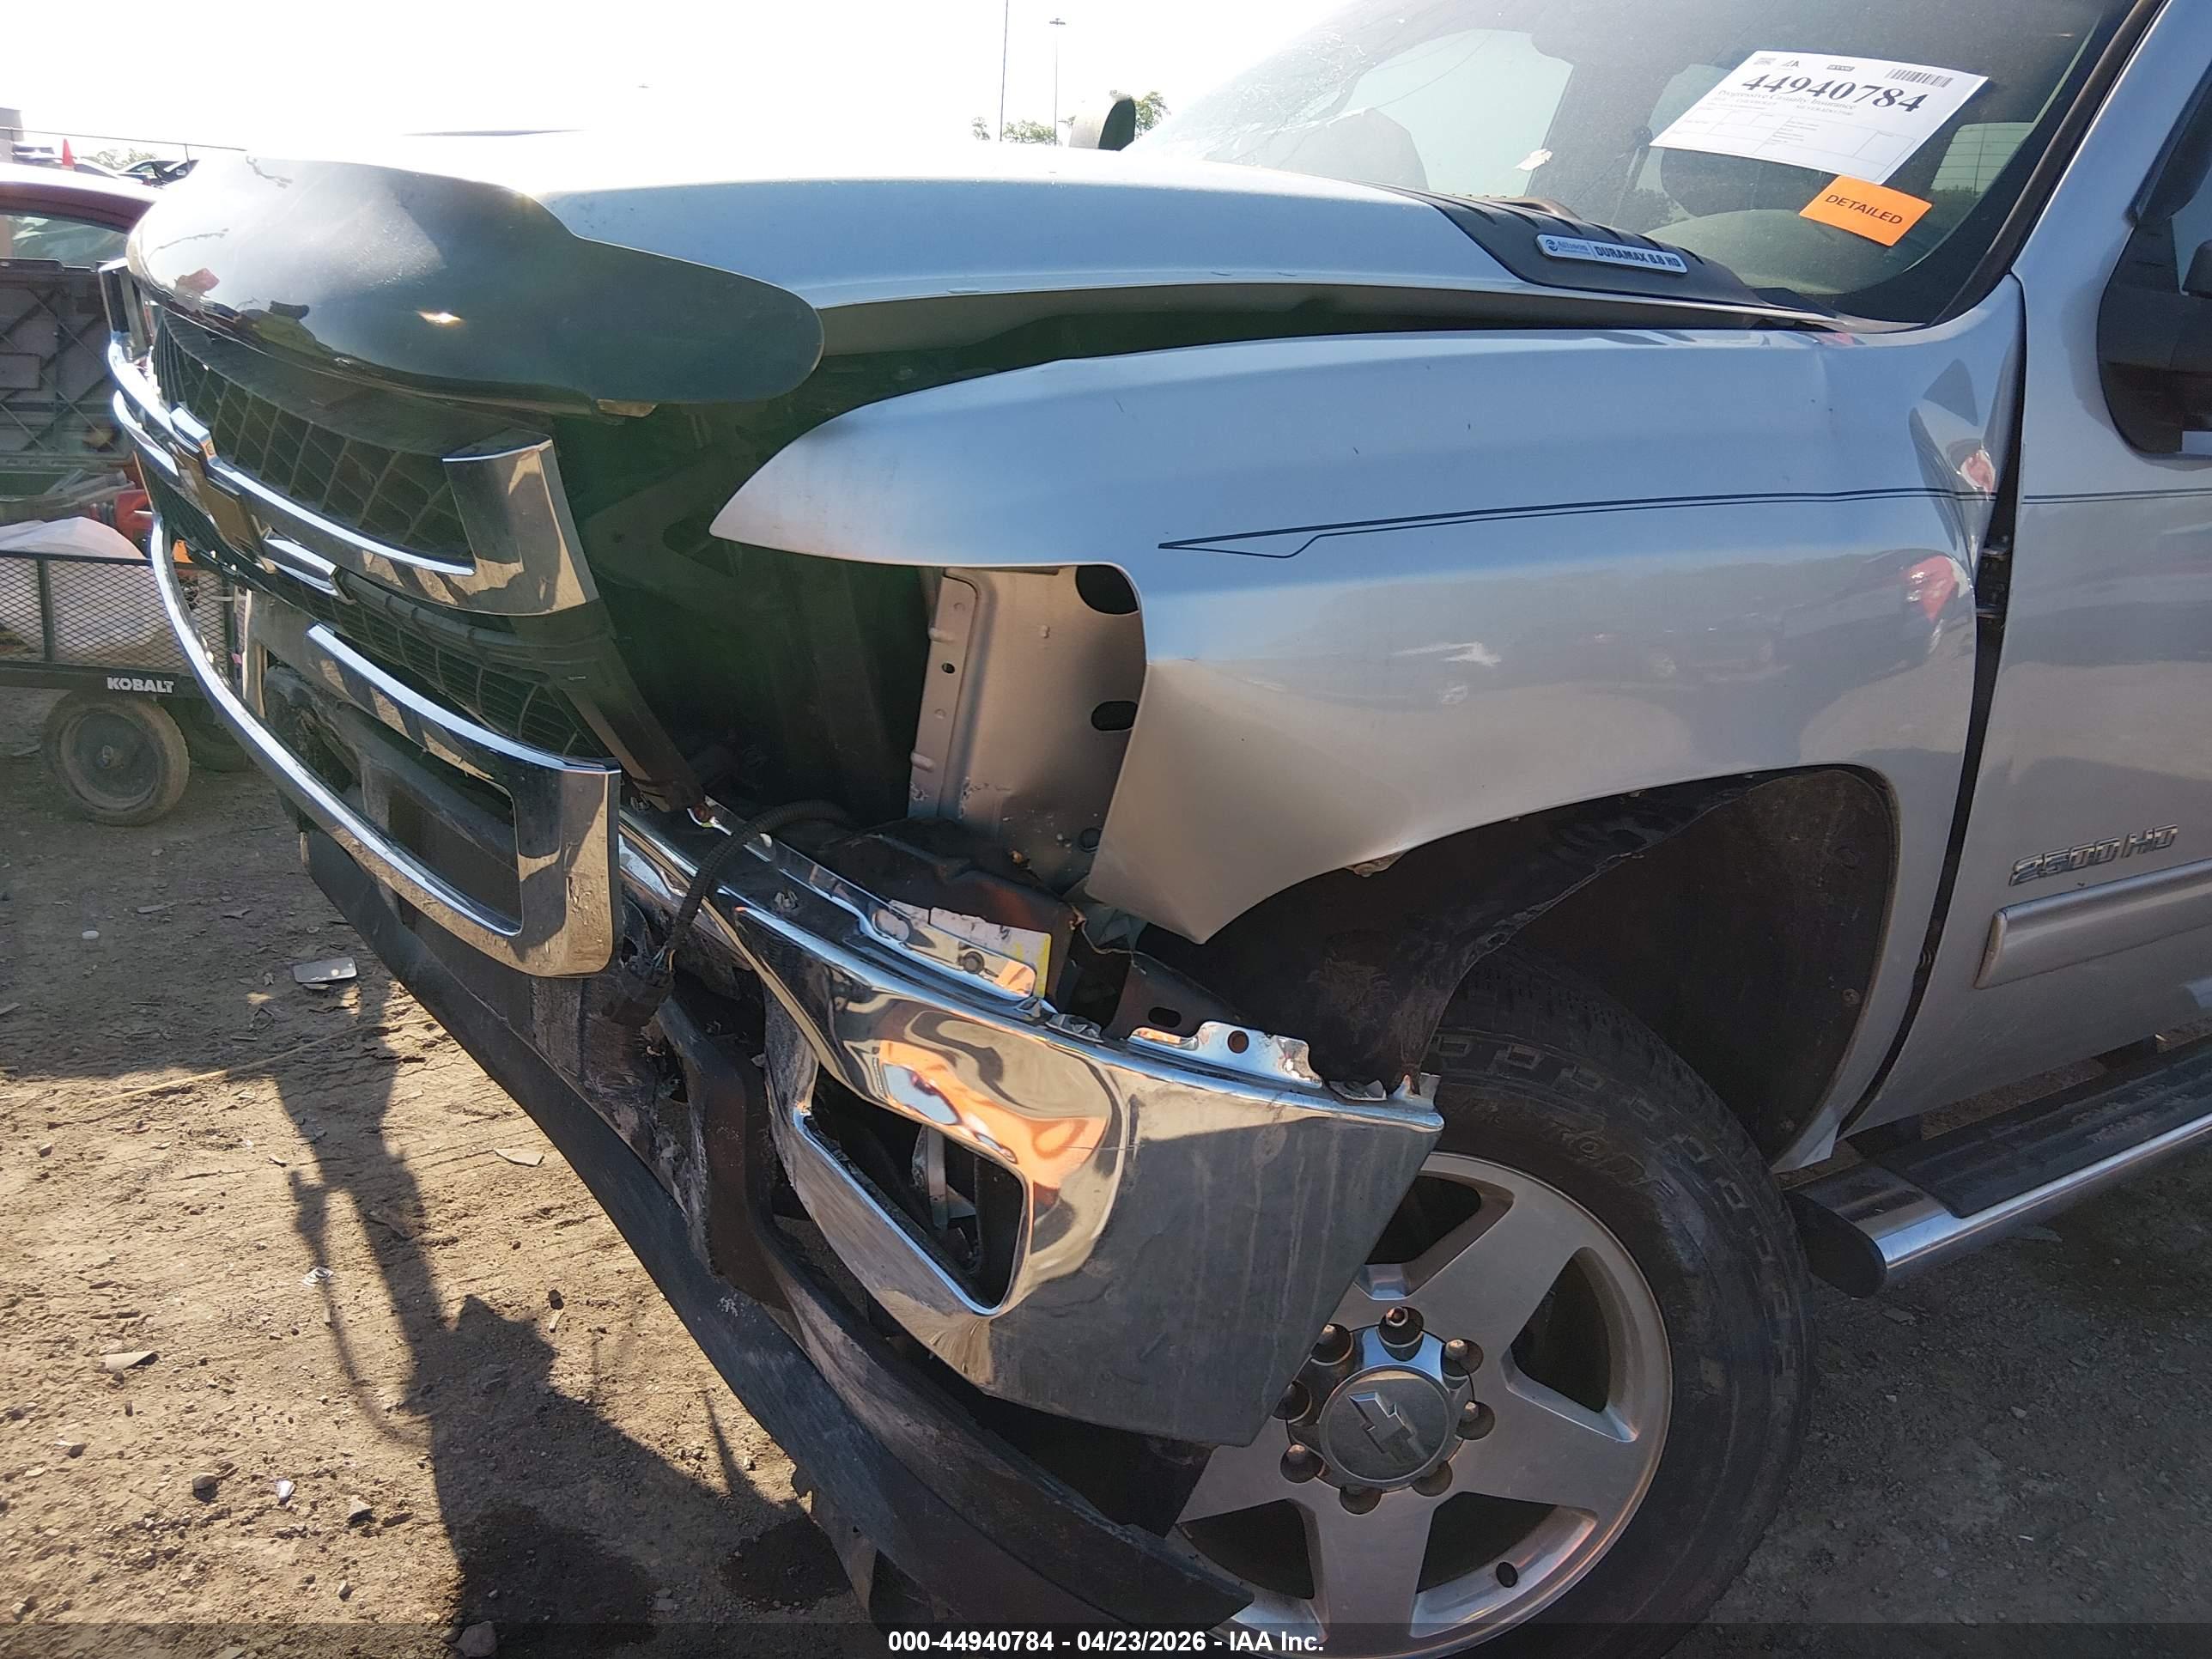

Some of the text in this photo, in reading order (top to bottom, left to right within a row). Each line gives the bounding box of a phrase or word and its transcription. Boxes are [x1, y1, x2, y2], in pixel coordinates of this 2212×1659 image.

[1741, 74, 1929, 112] 44940784
[1825, 194, 1903, 224] DETAILED
[1594, 246, 1647, 263] DURAMAX
[106, 677, 174, 694] KOBALT
